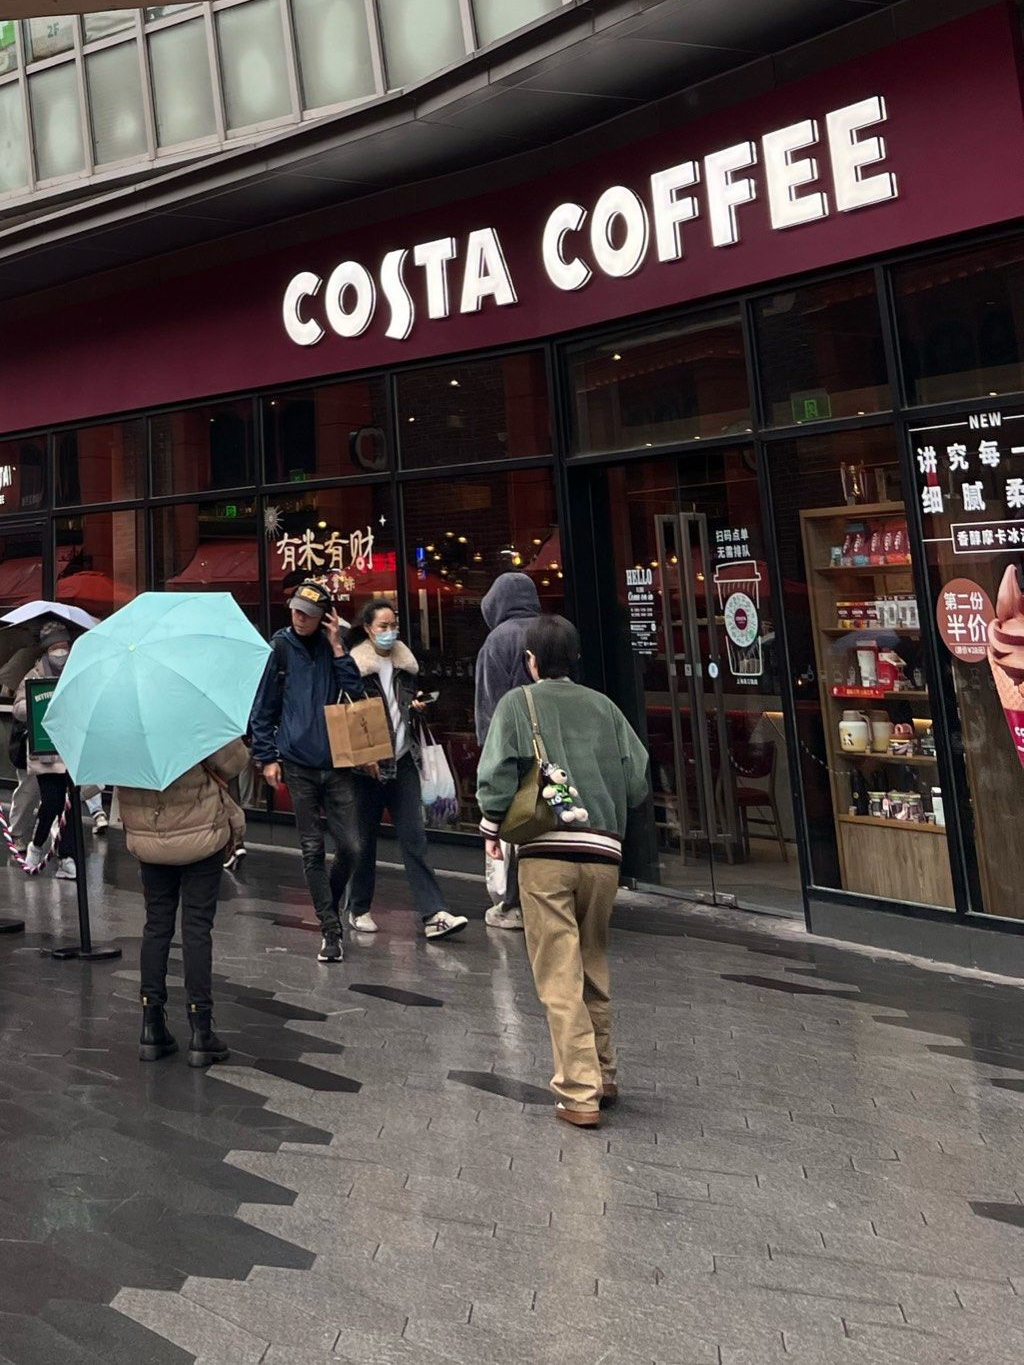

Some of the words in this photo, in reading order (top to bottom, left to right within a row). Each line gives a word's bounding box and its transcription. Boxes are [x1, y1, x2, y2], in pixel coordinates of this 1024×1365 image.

[47, 22, 60, 39] 2F
[282, 227, 518, 347] COSTA
[542, 96, 899, 292] COFFEE
[969, 412, 1002, 429] NEW
[715, 528, 749, 543] 扫码点单
[276, 526, 375, 571] 有米有财
[717, 545, 751, 559] 无需排队
[625, 568, 653, 586] HELLO
[943, 592, 984, 611] 第二份
[947, 614, 987, 642] 半价
